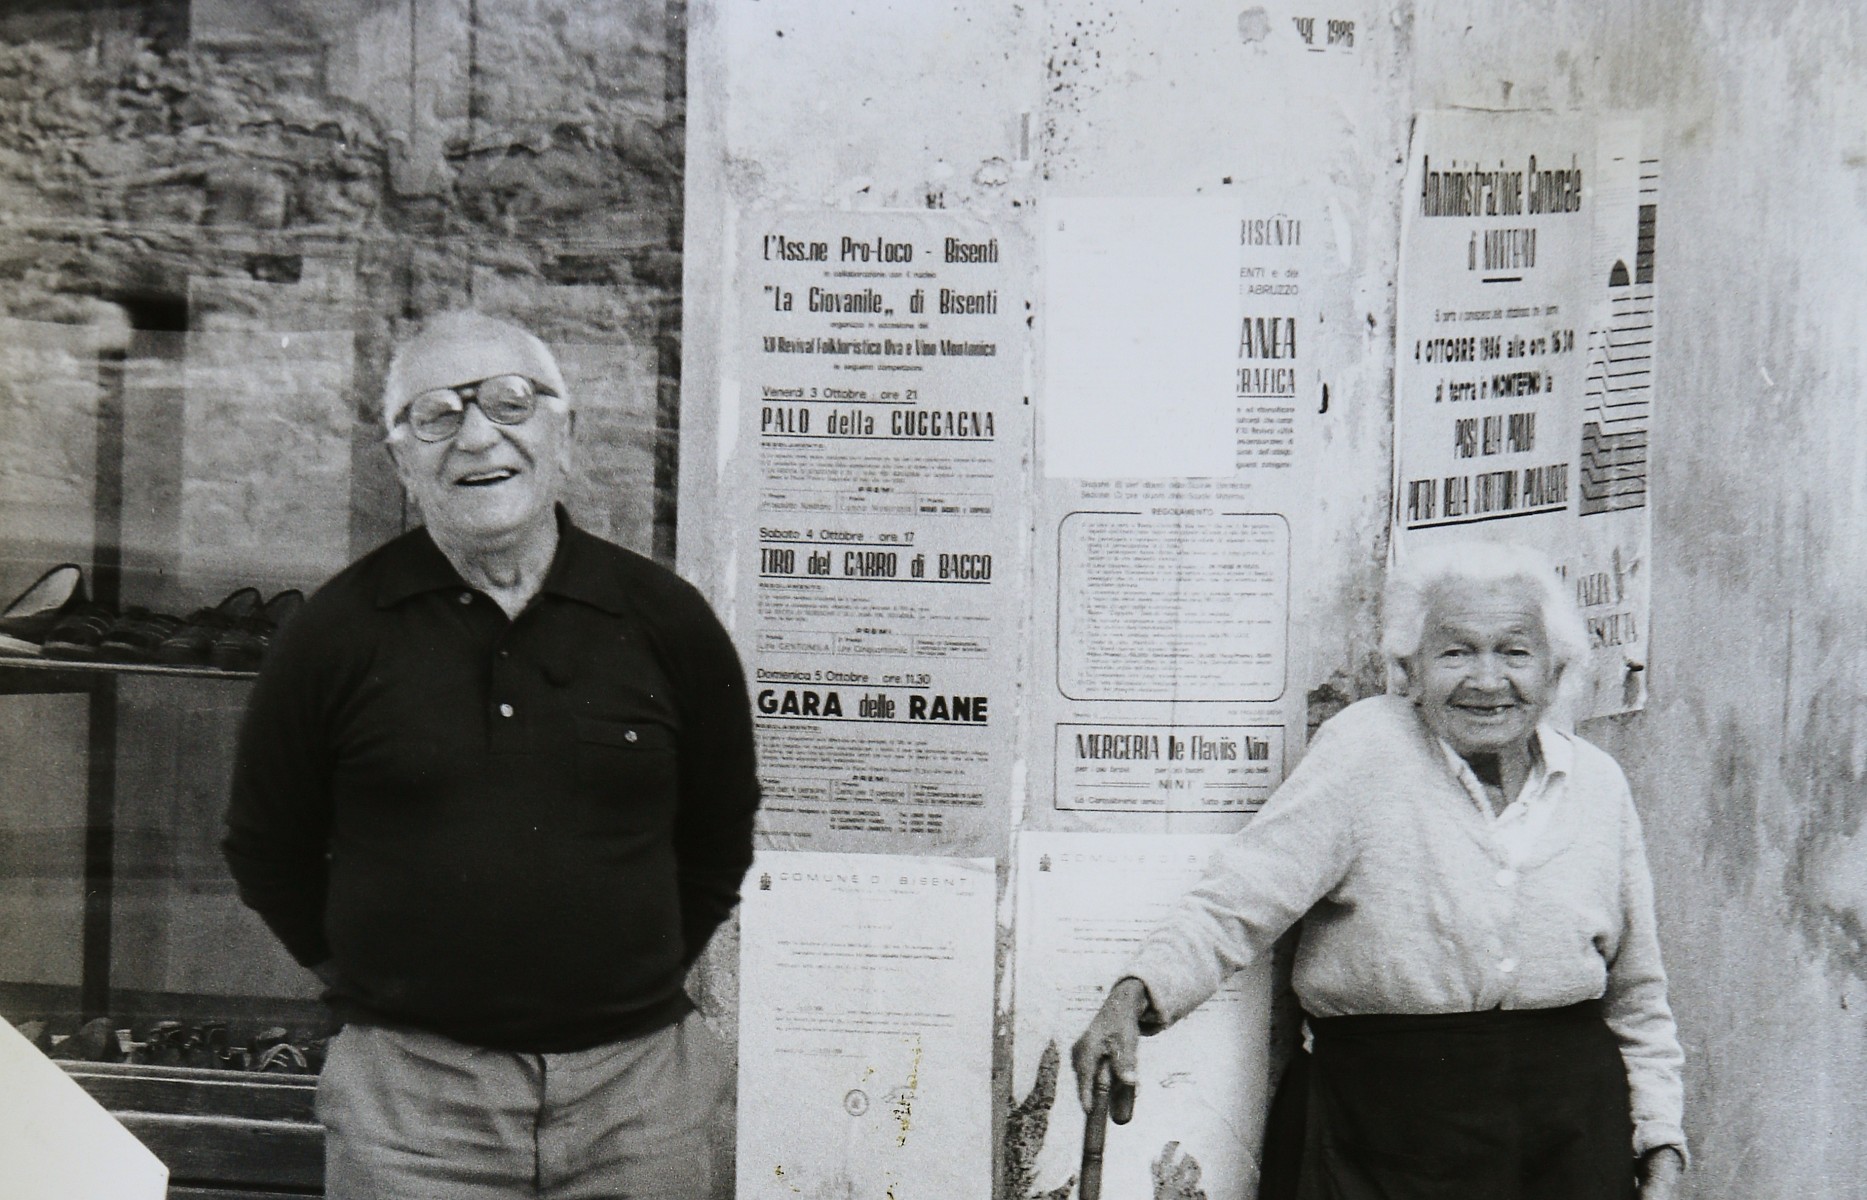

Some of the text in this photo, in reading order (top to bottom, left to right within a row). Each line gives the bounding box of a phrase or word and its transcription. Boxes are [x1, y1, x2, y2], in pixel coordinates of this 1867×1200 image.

[841, 236, 913, 263] Pro-Loco
[944, 237, 998, 263] Bisenti
[1271, 269, 1278, 278] e
[910, 289, 925, 314] di
[940, 288, 998, 315] Bisenti
[1248, 284, 1299, 296] ABRUZZO
[778, 337, 815, 355] Revival
[1414, 339, 1421, 364] 4
[1425, 336, 1475, 363] OTTOBRE
[1480, 335, 1502, 361] 1986
[1507, 334, 1526, 359] alle
[1529, 336, 1546, 356] ore
[810, 388, 818, 399] 3
[823, 388, 867, 399] Ottobre
[880, 391, 899, 400] ore
[905, 390, 918, 400] 21
[761, 407, 995, 437] PALO della CUCCAGNA
[759, 527, 915, 542] Sabato 4 Ottobre ore 17
[761, 548, 992, 580] TIRO del CARRO di BACCO
[756, 668, 812, 681] Domenica
[814, 671, 822, 681] 5
[825, 671, 869, 683] Ottobre
[882, 675, 901, 684] ore
[757, 689, 988, 722] GARA delle RANE
[1075, 733, 1160, 761] MERCERIA
